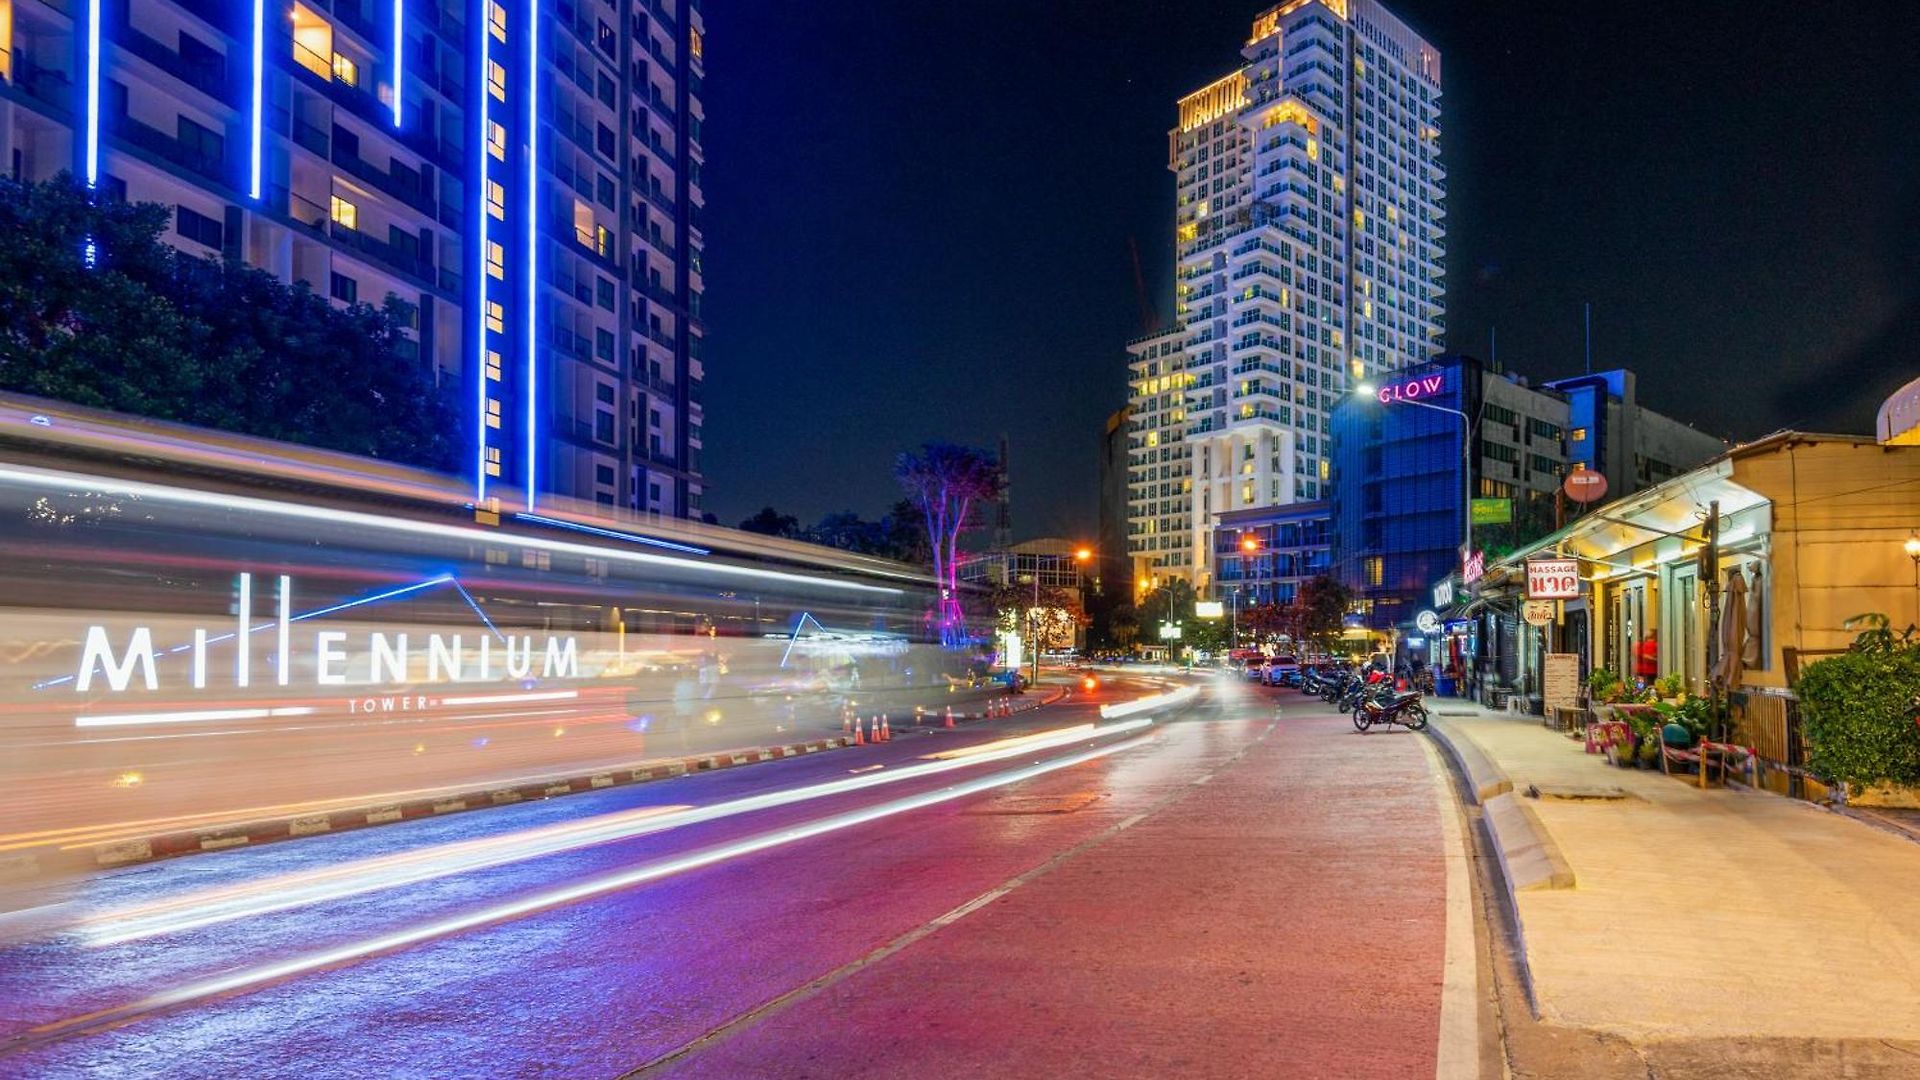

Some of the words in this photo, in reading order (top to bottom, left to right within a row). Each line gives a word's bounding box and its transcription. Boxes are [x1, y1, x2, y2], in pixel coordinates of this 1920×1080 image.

[1379, 376, 1442, 403] GLOW
[1529, 565, 1576, 574] MASSAGE
[1530, 577, 1576, 593] นวด
[349, 696, 428, 714] TOWER
